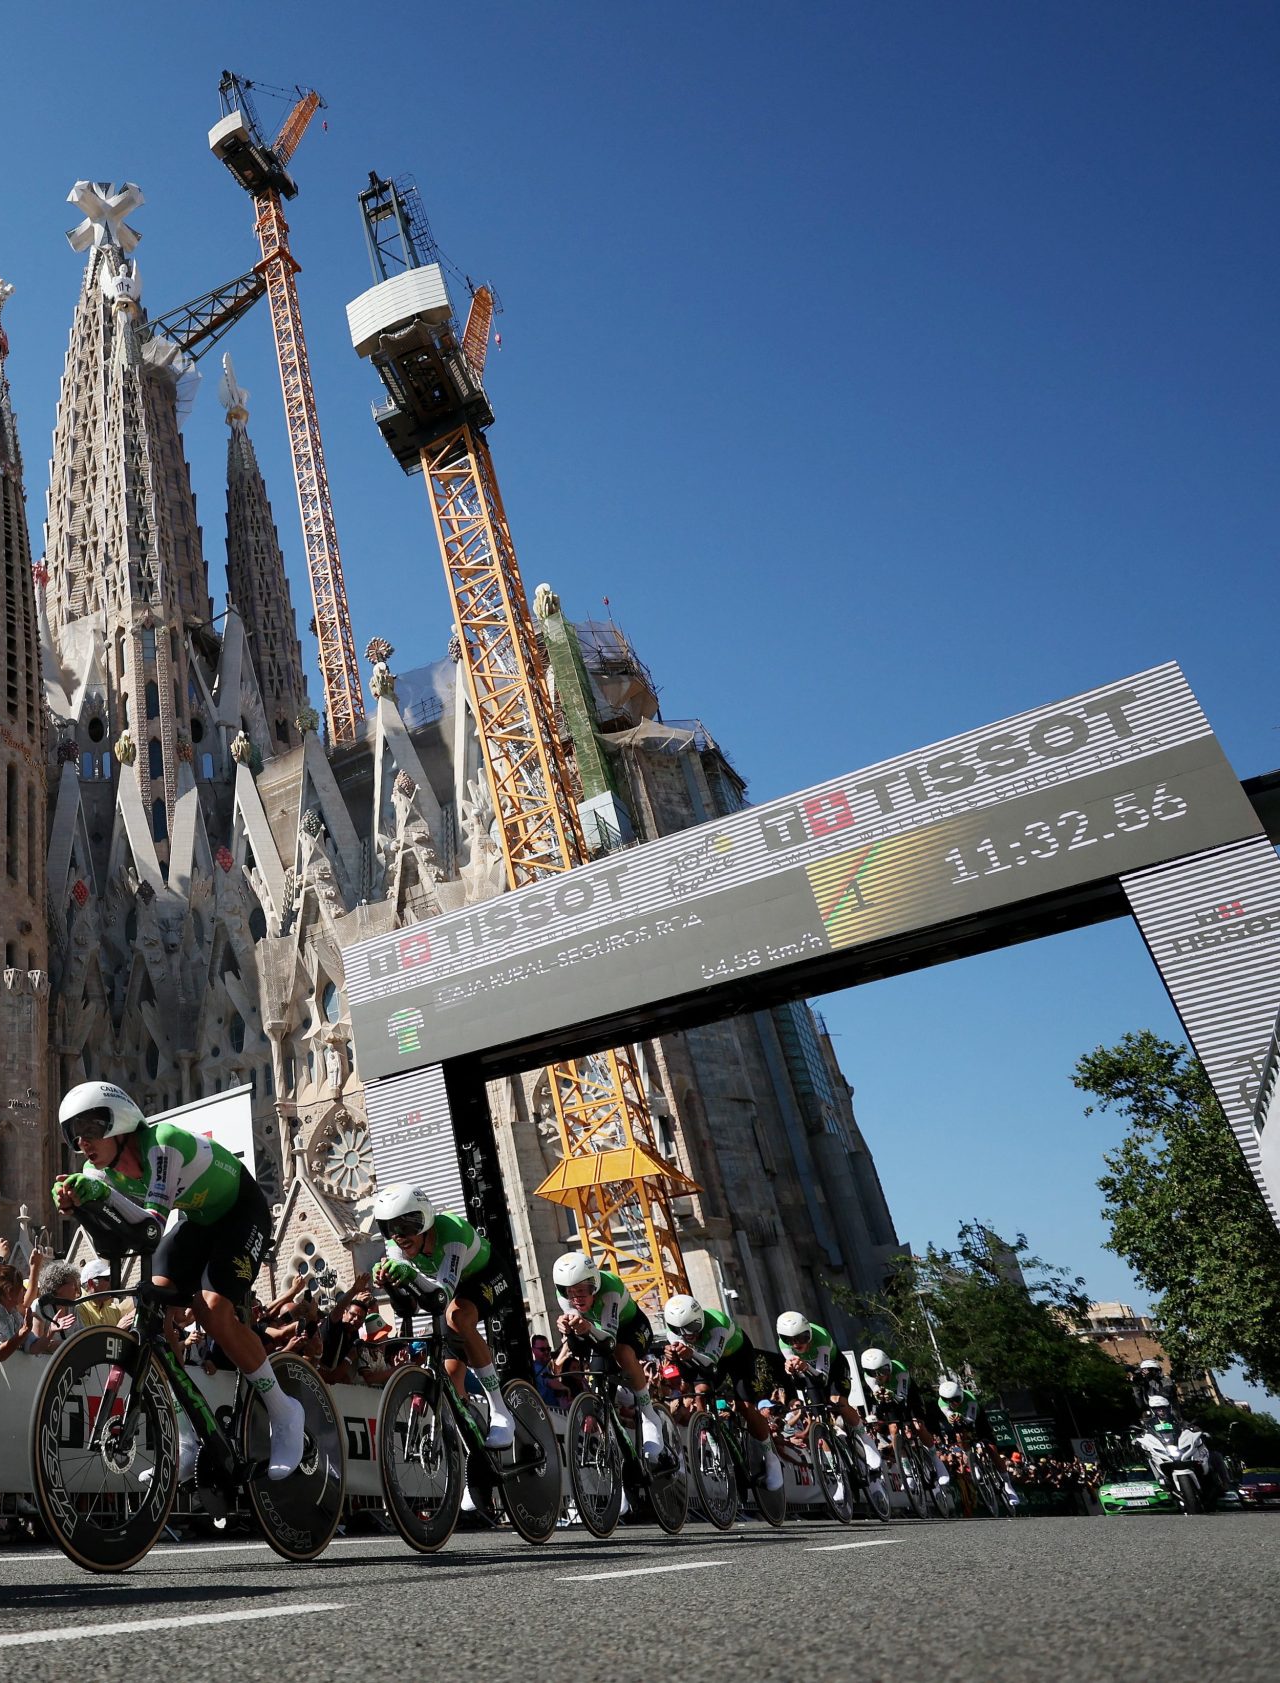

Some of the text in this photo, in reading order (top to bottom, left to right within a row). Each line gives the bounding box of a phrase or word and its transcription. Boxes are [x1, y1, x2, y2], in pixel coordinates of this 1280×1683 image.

[855, 689, 1137, 815] TISSOT
[945, 782, 1187, 884] 11:32.56
[433, 864, 629, 953] TISSOT
[251, 1232, 265, 1262] RGA
[494, 1280, 509, 1296] RGA
